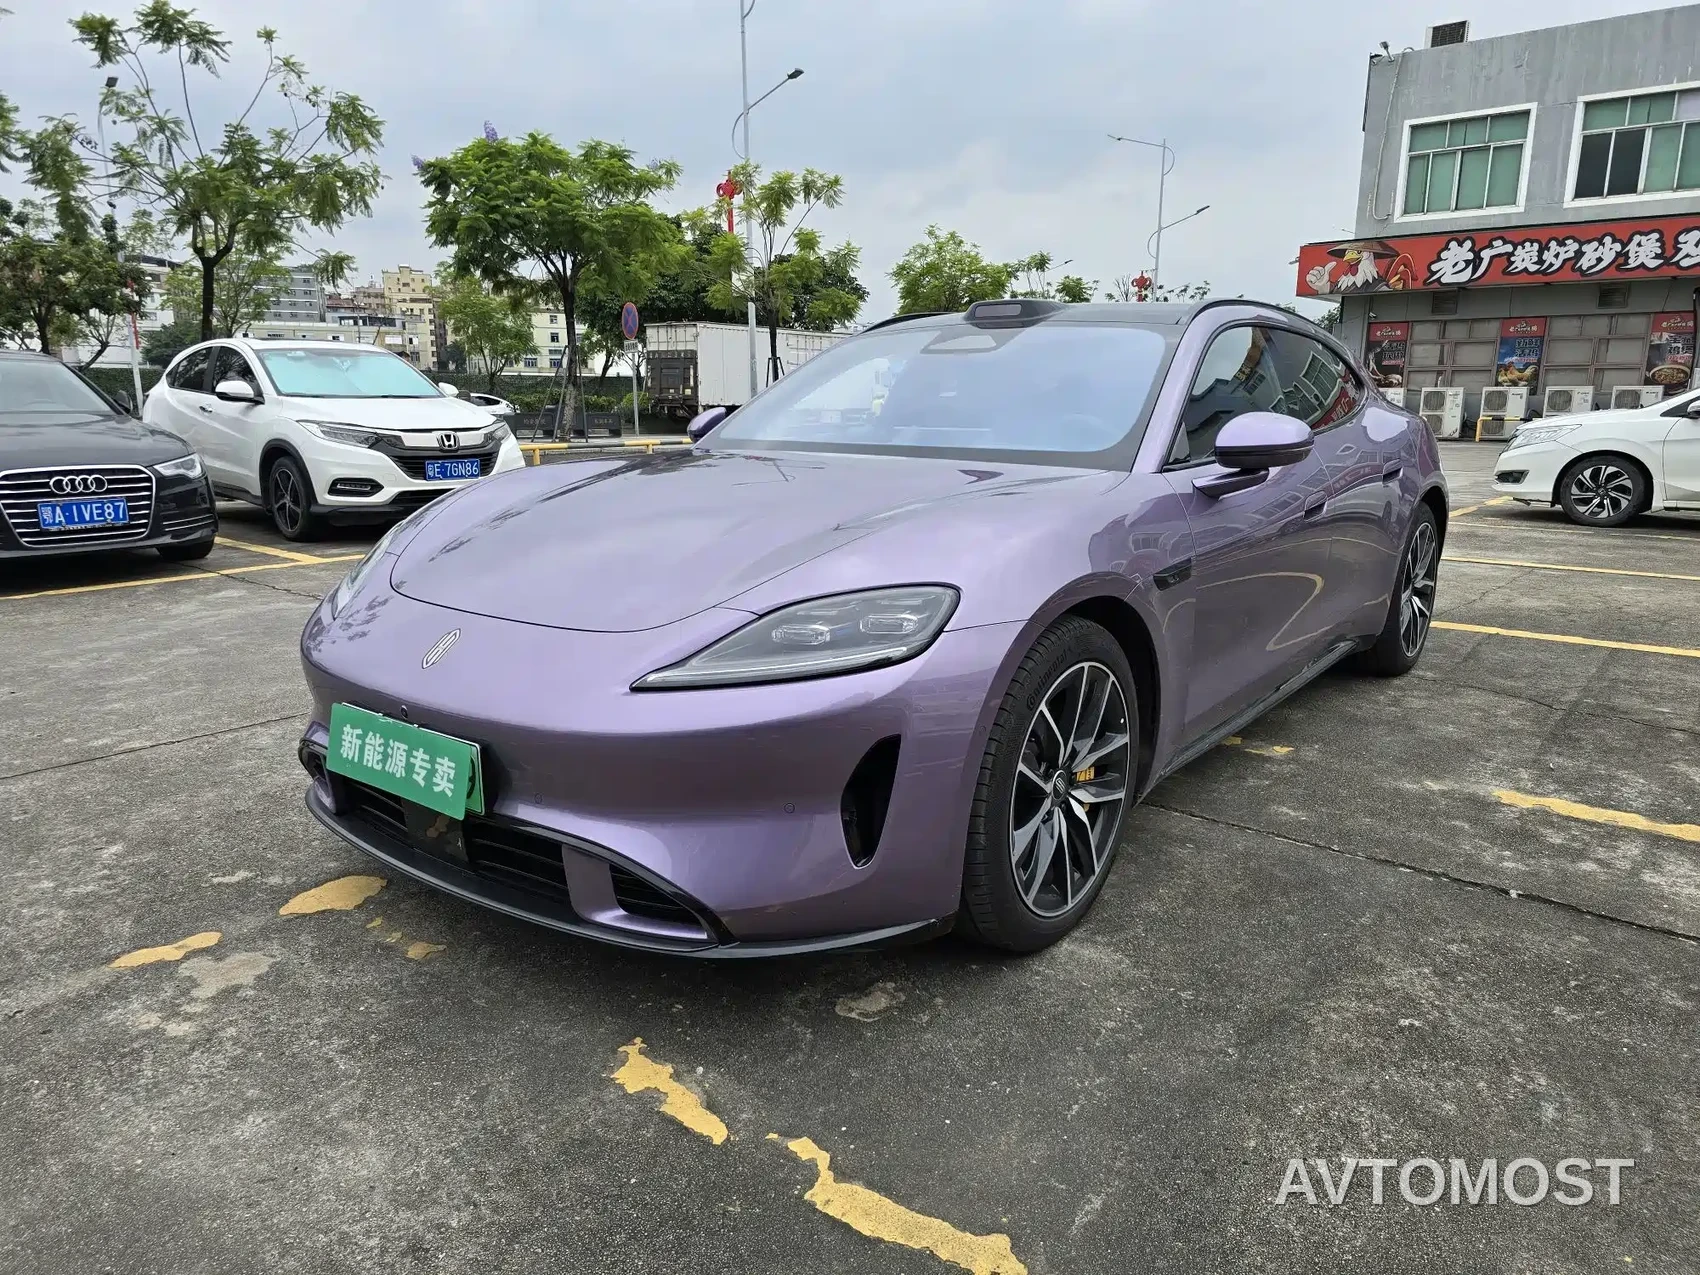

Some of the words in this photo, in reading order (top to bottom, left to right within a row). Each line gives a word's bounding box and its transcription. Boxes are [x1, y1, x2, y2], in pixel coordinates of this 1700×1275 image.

[340, 723, 457, 798] 新能源专卖
